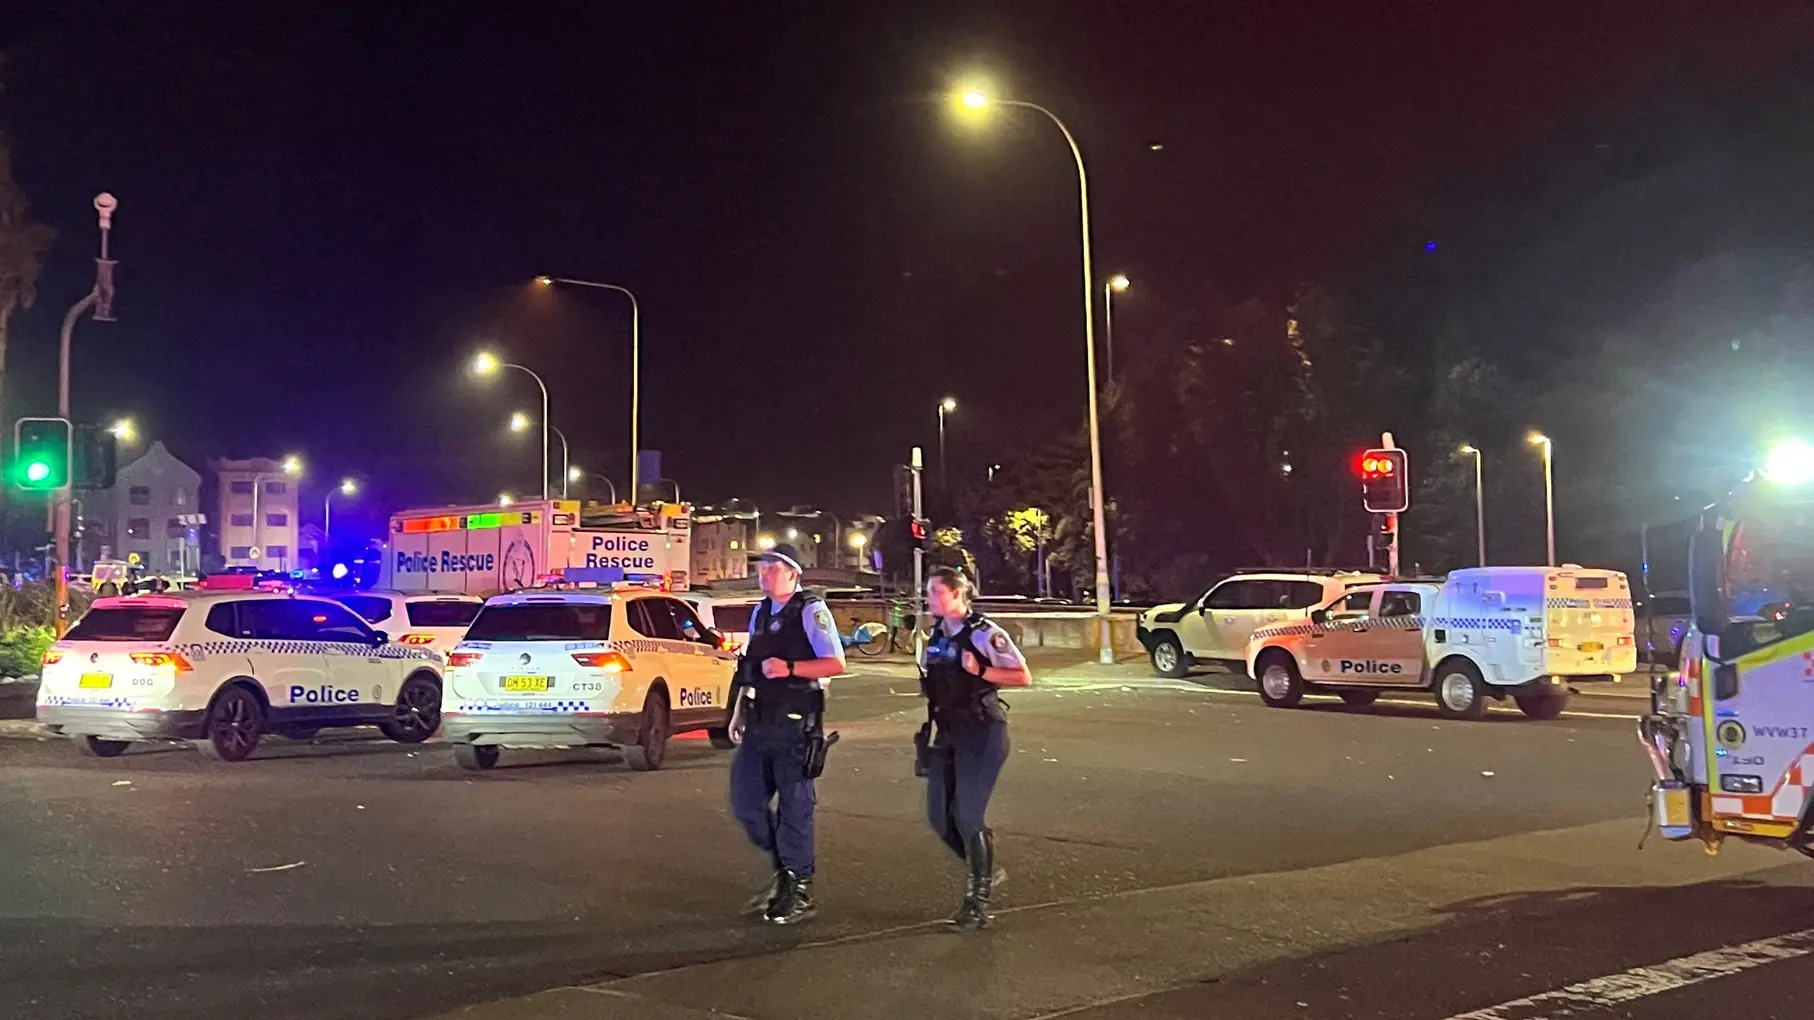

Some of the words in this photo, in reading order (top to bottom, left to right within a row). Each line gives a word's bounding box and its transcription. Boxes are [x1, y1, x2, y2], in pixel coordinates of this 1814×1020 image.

[592, 536, 648, 551] Police
[396, 550, 437, 573] Police
[442, 549, 494, 572] Rescue
[585, 553, 655, 569] Rescue
[1340, 660, 1402, 674] Police
[290, 685, 360, 703] Police
[572, 682, 602, 692] CT38
[680, 687, 711, 706] Police
